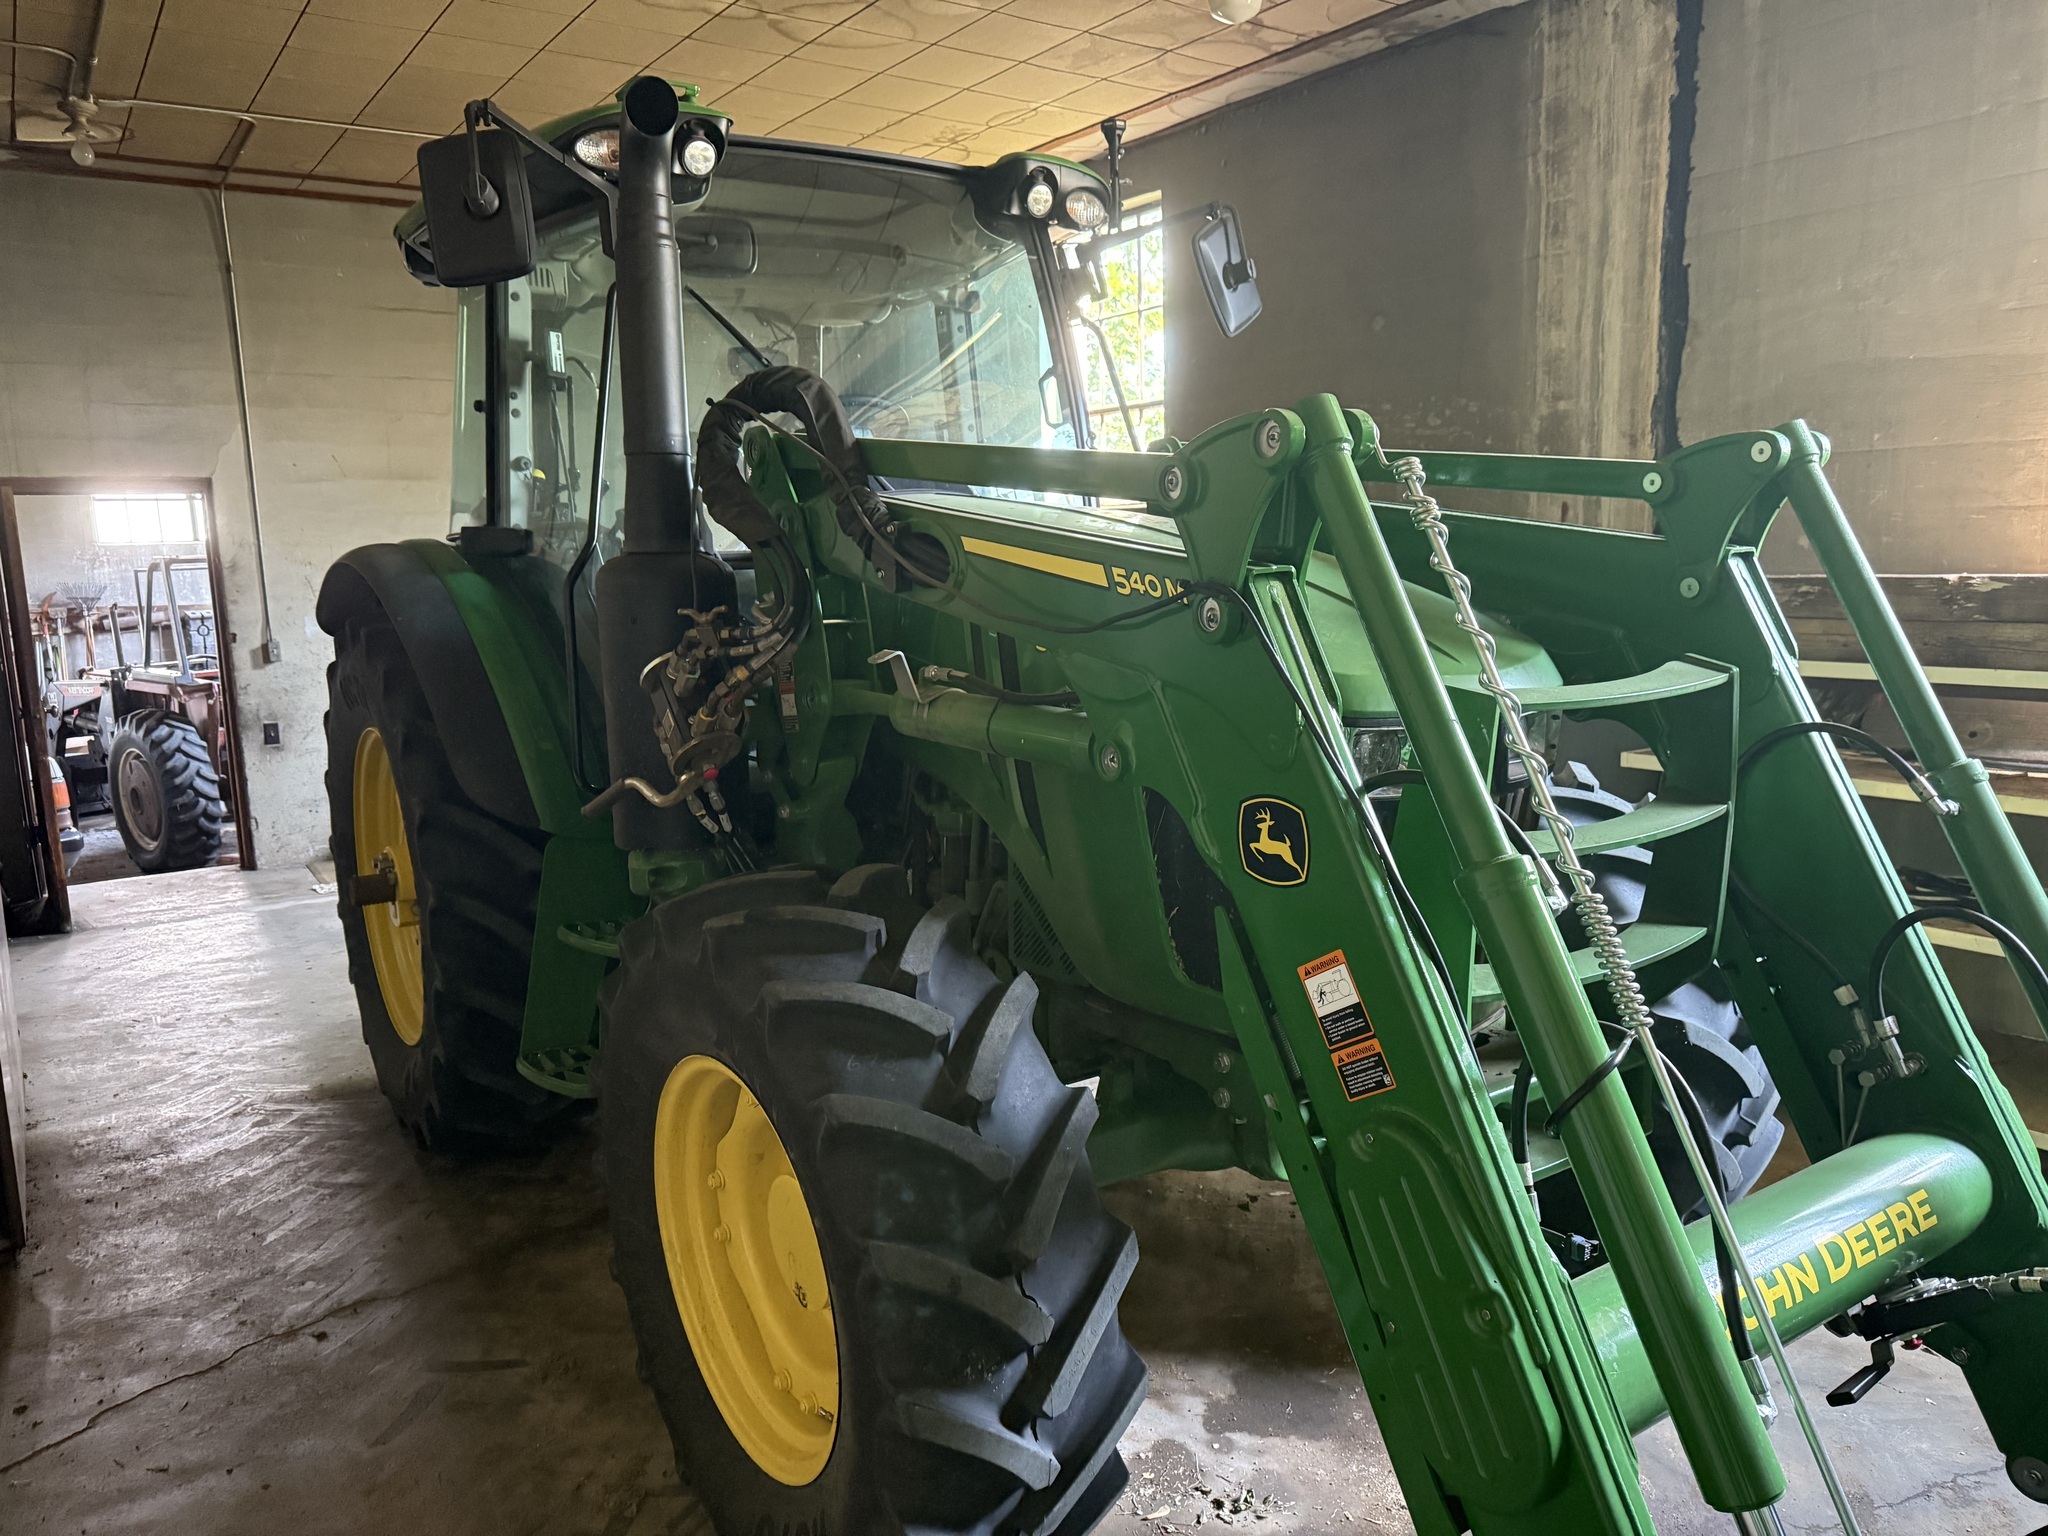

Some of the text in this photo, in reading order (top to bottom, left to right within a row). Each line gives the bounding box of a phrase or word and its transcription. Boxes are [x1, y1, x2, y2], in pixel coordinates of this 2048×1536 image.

[1310, 956, 1340, 973] WARNING
[1345, 1044, 1376, 1060] WARNING
[1714, 1188, 1938, 1342] HN DEERE
